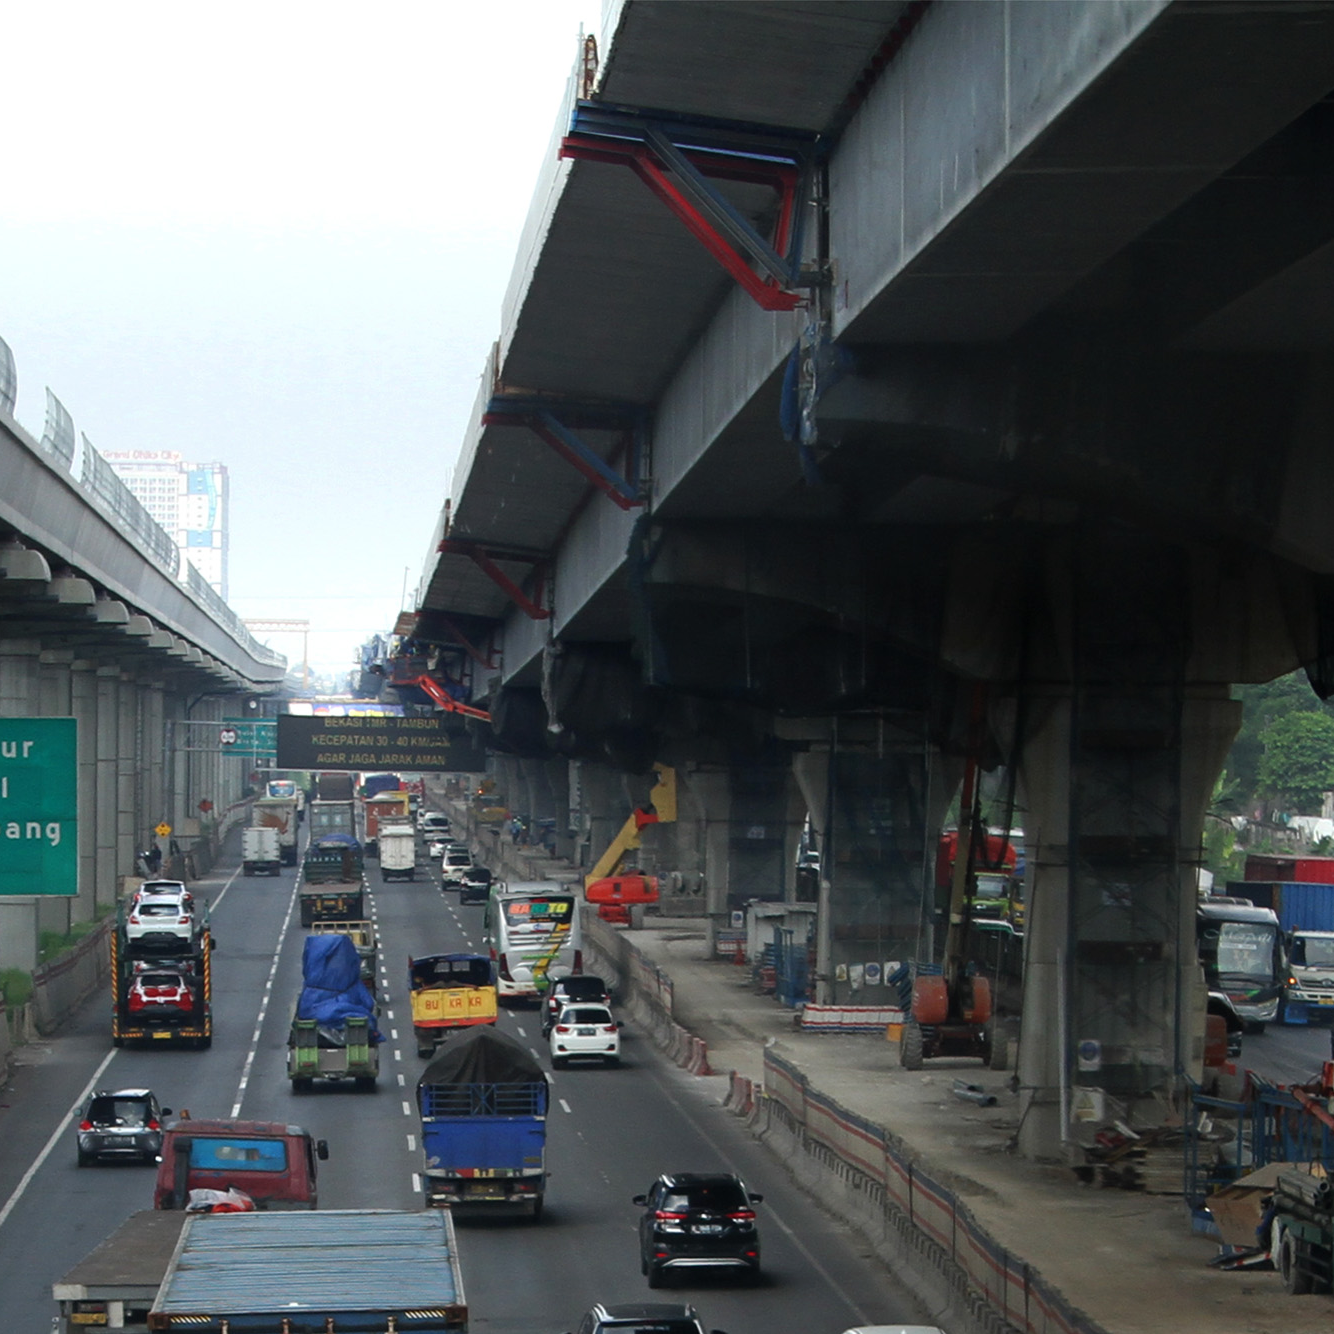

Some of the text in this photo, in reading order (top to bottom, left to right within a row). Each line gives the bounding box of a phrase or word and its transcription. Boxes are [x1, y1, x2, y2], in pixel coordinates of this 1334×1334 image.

[324, 718, 363, 728] BEKASI
[397, 718, 439, 729] TAMBUN
[311, 734, 374, 746] KECEPATAN
[377, 735, 388, 746] 30
[397, 736, 408, 746] 40
[317, 753, 446, 765] AGAR JAGA JARAK AMAN
[425, 996, 482, 1010] BU KA KA
